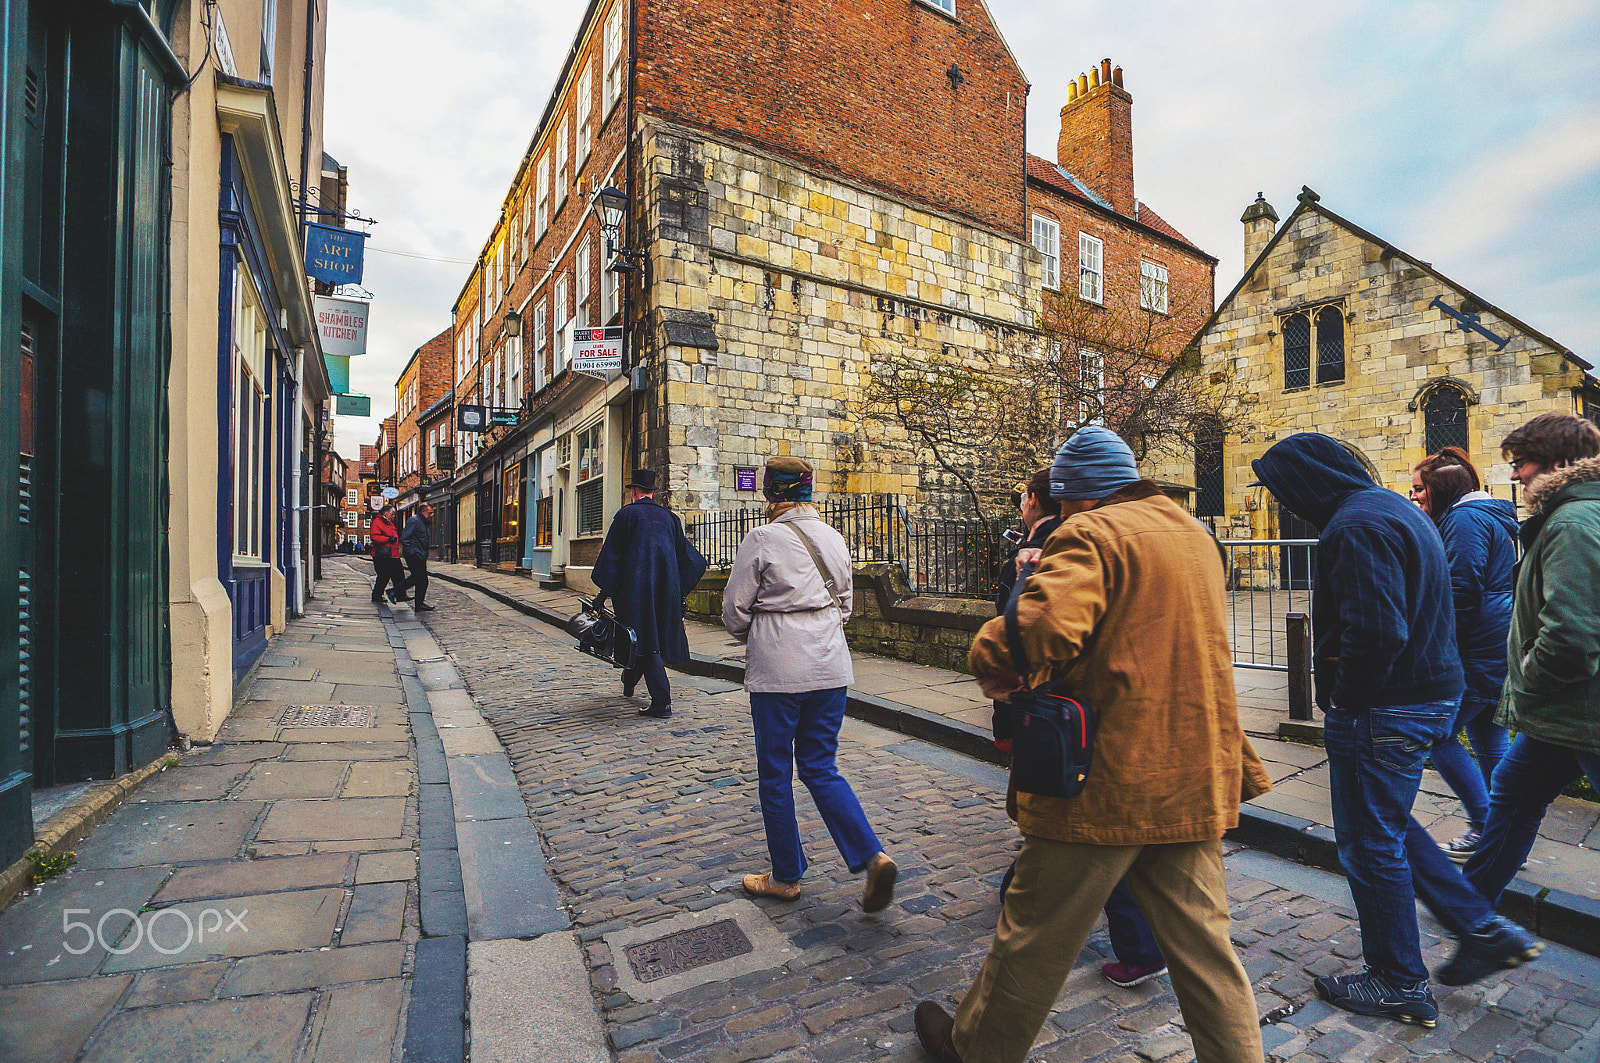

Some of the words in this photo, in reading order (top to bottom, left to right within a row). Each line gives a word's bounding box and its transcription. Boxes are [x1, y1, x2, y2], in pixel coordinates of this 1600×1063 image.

[320, 243, 352, 257] ART
[314, 258, 354, 273] SHOP
[318, 311, 364, 328] SHAMBLES
[323, 325, 358, 341] KITCHEN
[579, 349, 595, 358] FOR
[597, 348, 617, 357] SALE
[596, 360, 621, 368] 659990
